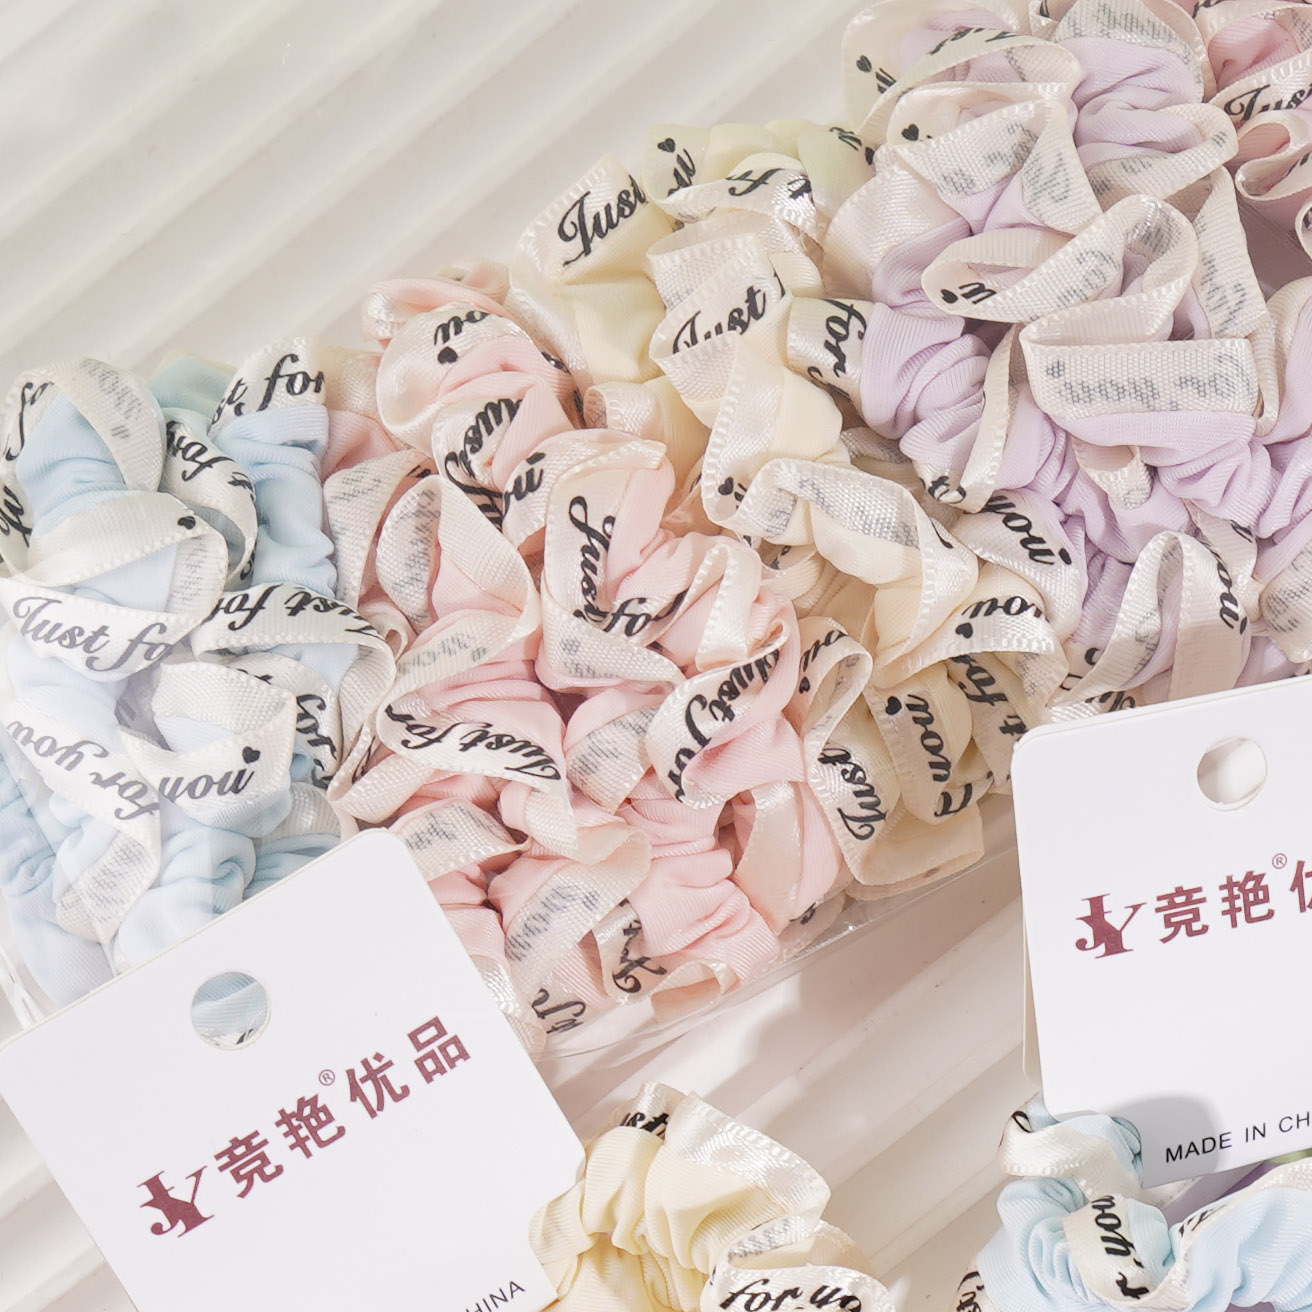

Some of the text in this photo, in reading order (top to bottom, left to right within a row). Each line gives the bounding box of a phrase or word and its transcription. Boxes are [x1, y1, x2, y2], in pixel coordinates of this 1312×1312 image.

[85, 620, 175, 673] fo
[1165, 1131, 1233, 1163] MADE
[1245, 1122, 1266, 1143] IN
